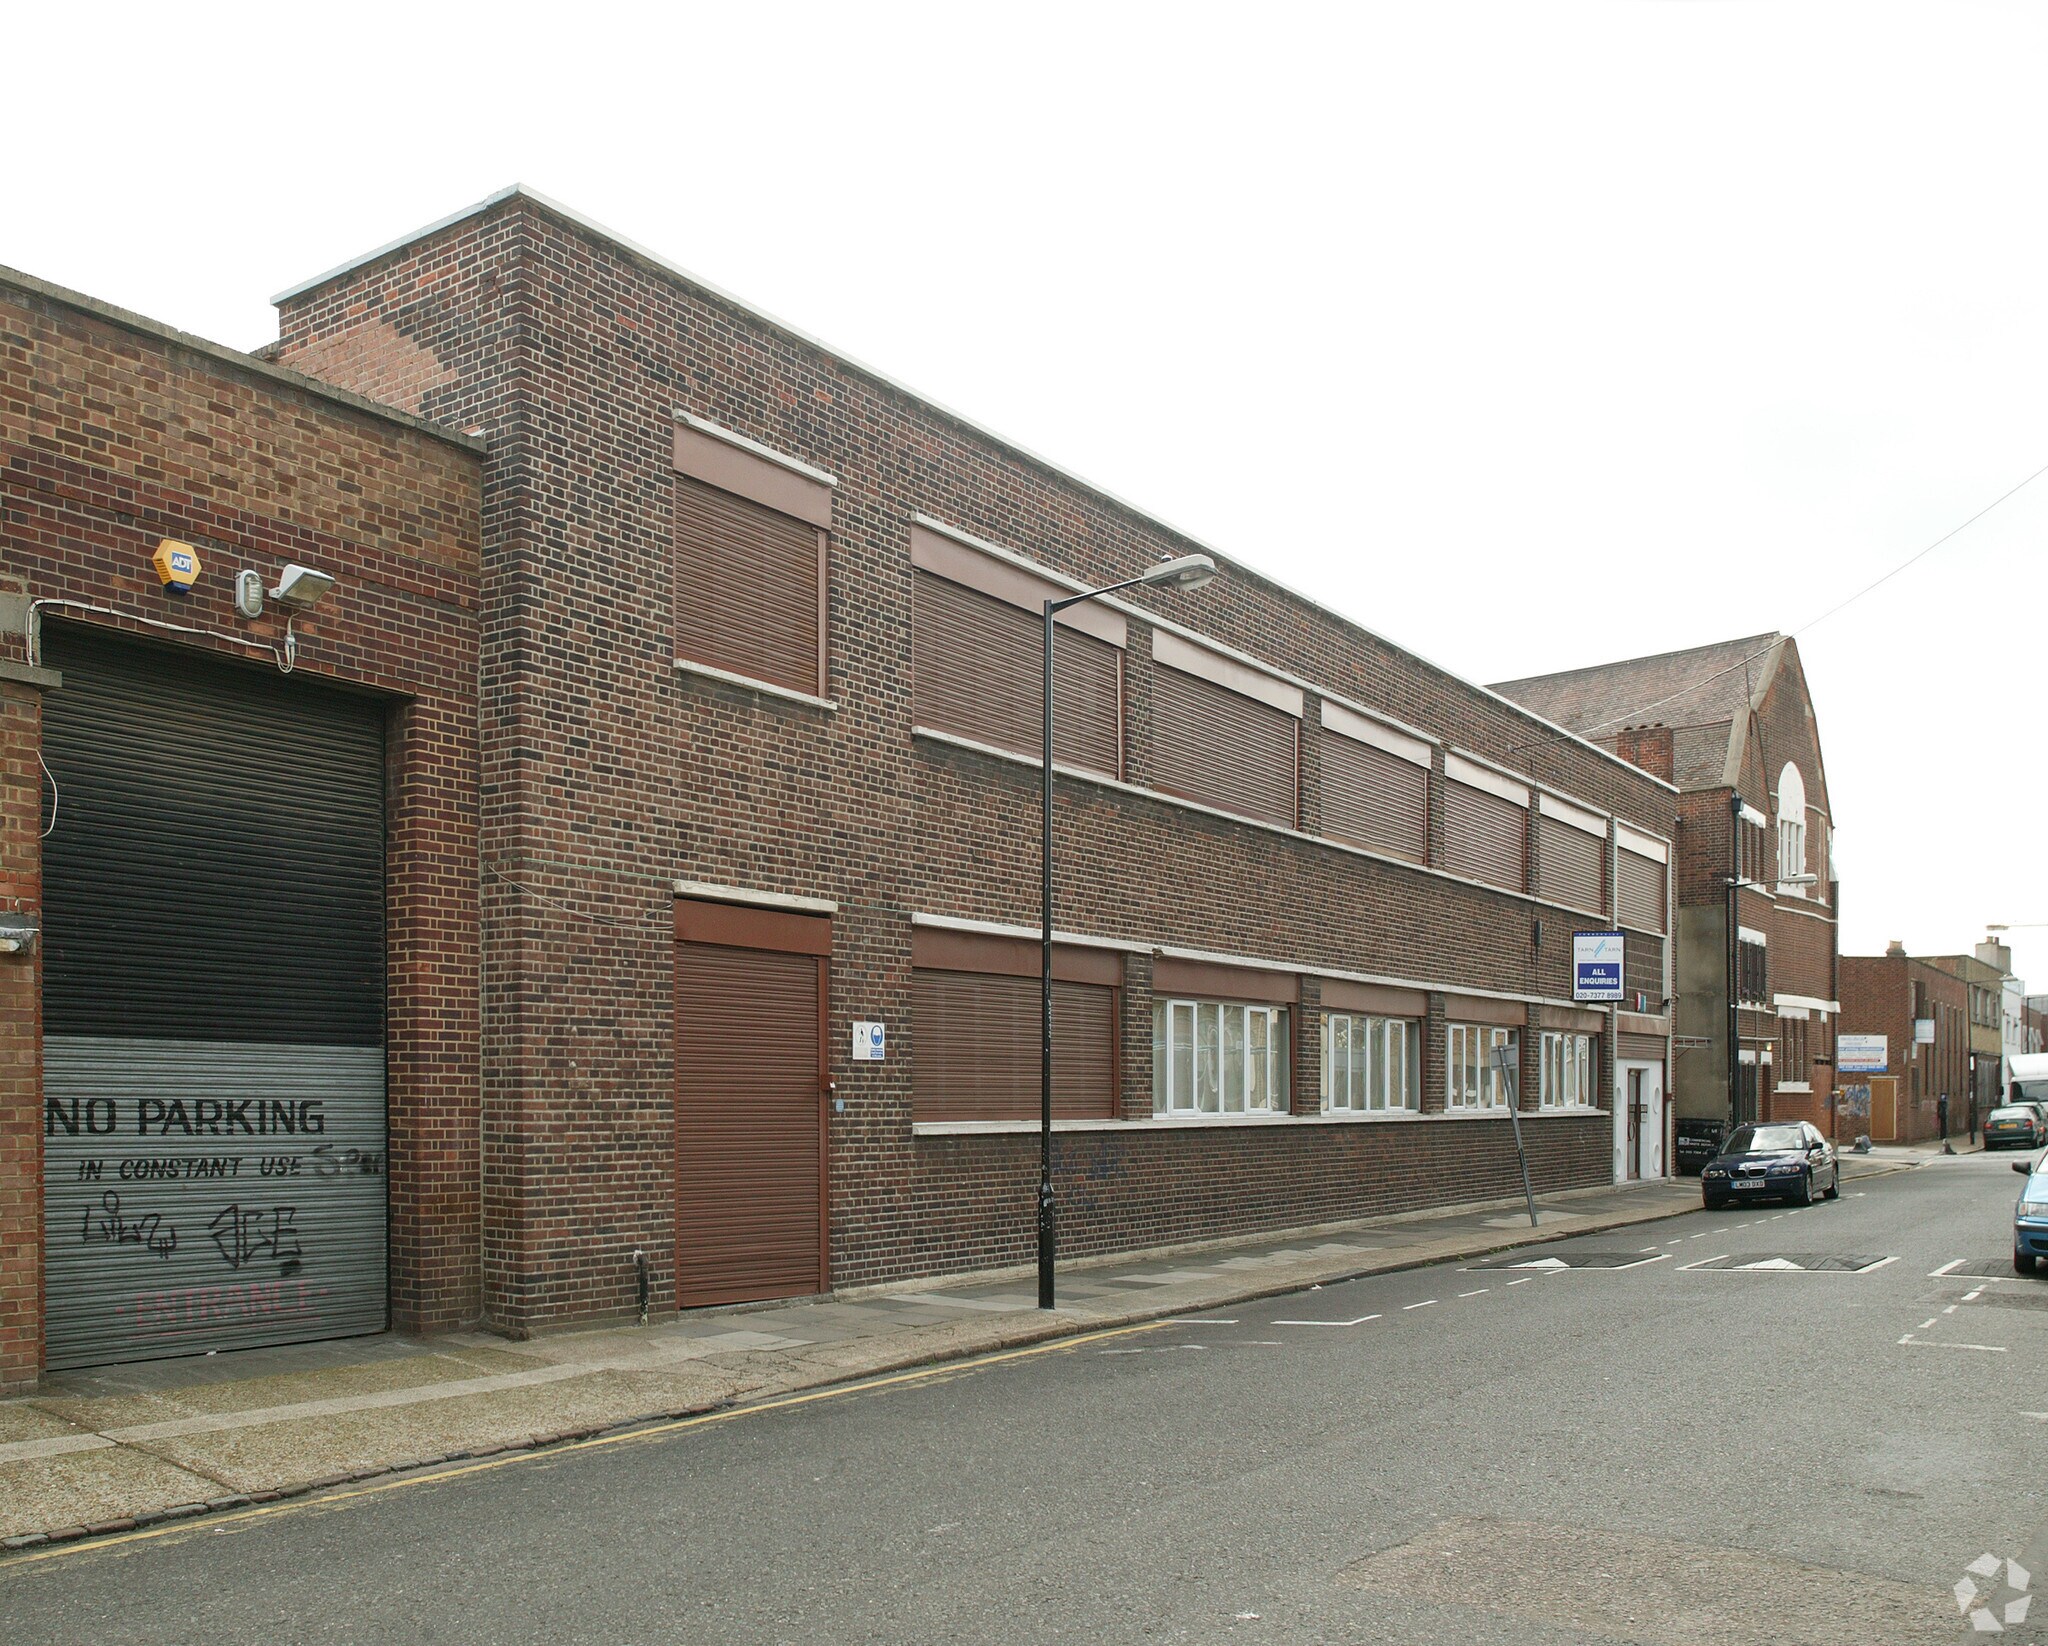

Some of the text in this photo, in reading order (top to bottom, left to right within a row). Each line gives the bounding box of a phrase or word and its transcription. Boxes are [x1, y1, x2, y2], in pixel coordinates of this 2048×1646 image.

[172, 556, 192, 570] ADT
[1592, 968, 1606, 976] ALL
[1579, 977, 1618, 985] ENQUIRIES
[46, 1098, 325, 1136] NO PARKING
[78, 1159, 104, 1181] IN
[119, 1157, 243, 1180] CONSTANT
[260, 1156, 303, 1177] USE
